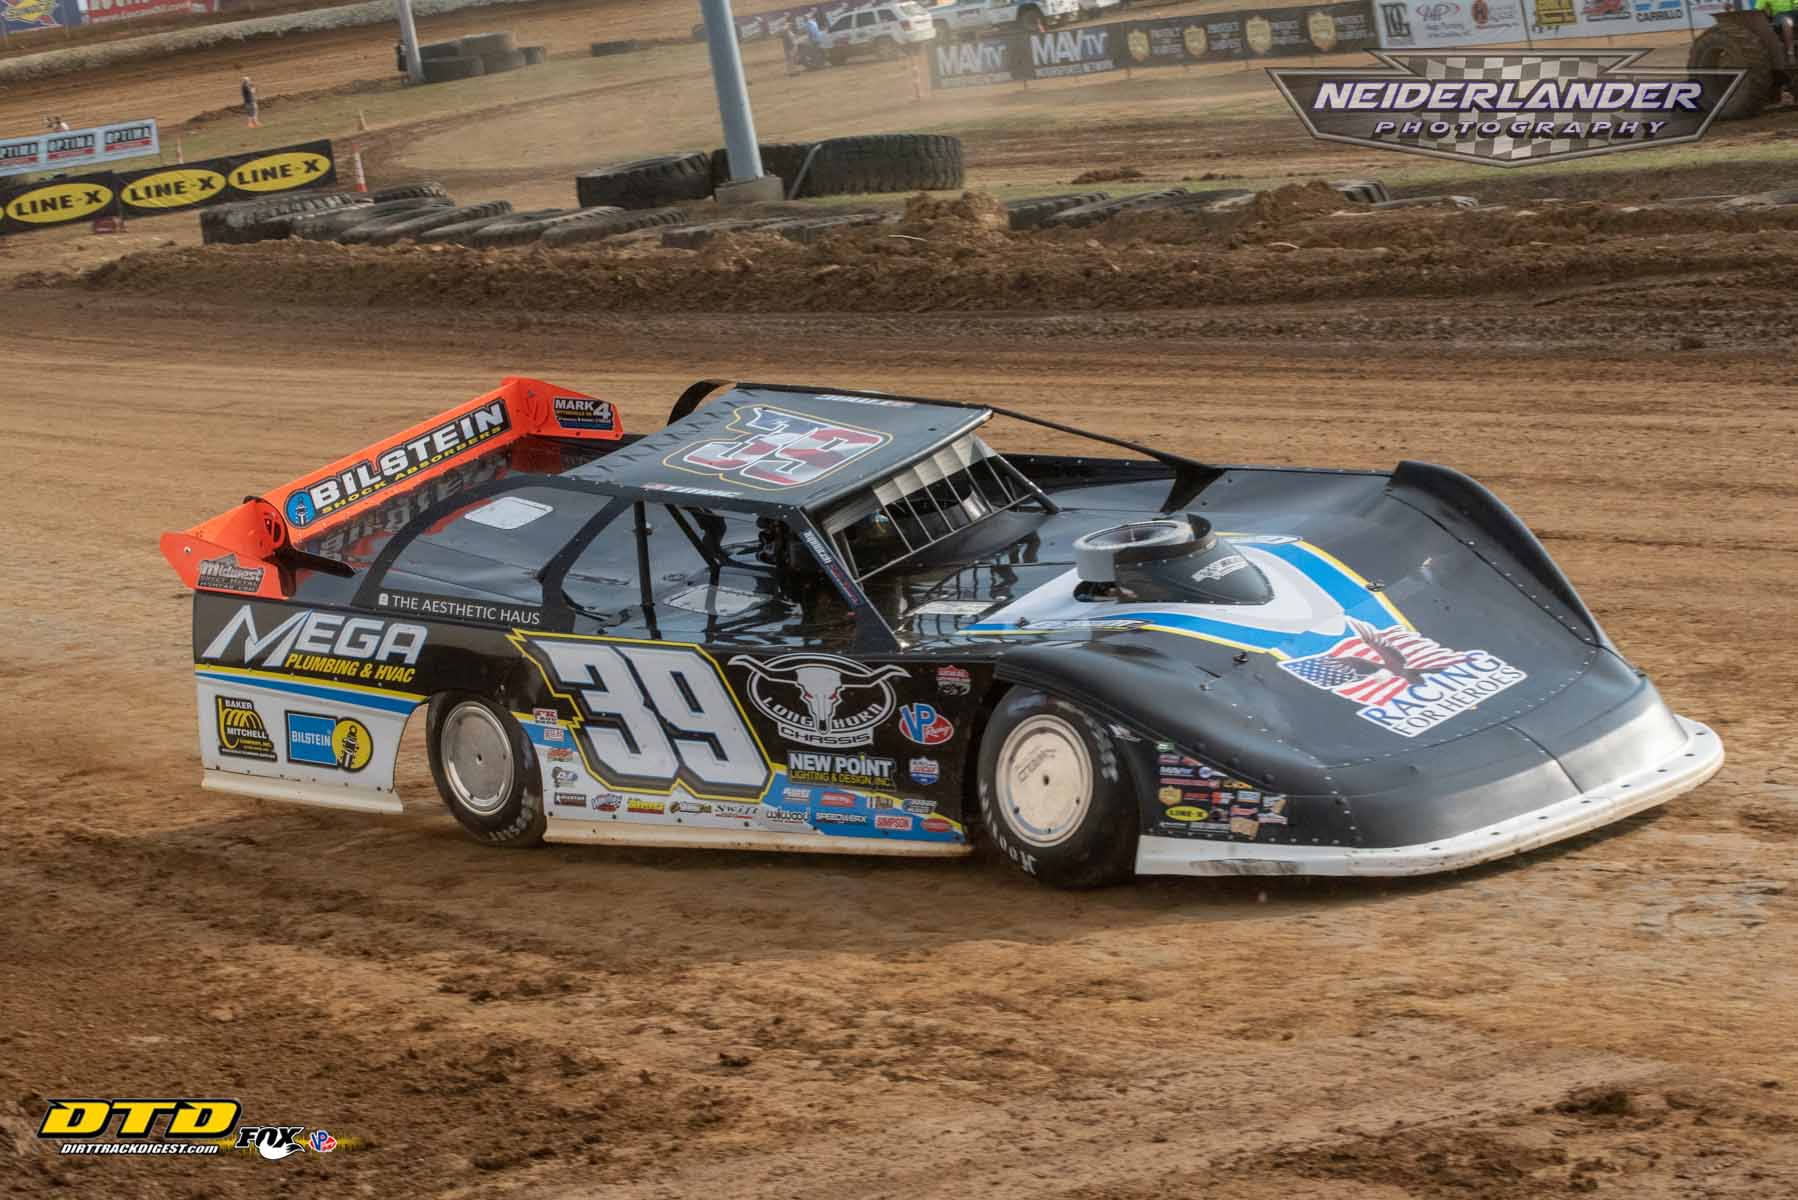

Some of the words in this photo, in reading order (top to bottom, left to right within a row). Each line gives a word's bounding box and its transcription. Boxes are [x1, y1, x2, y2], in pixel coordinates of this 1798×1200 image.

[105, 126, 152, 145] OPTIMA
[236, 158, 320, 185] LINE-X
[128, 176, 215, 202] LINE-X
[15, 190, 102, 217] LINE-X
[555, 399, 594, 411] MARK
[592, 402, 611, 419] 4
[309, 403, 504, 511] BILSTEIN
[321, 480, 387, 514] SHOCK
[394, 426, 502, 481] ABSORBERS
[392, 594, 419, 610] THE
[422, 599, 497, 620] AESTHETIC
[500, 610, 541, 625] HAUS
[201, 604, 428, 668] MEGA
[284, 652, 359, 678] PLUMBING
[360, 663, 373, 678] &
[376, 665, 416, 684] HVAC
[1364, 652, 1502, 727] RACING
[1394, 709, 1447, 735] FOR
[1443, 666, 1522, 712] HEROES
[225, 699, 253, 709] BAKER
[535, 640, 769, 787] 39
[226, 726, 268, 740] MITCHELL
[781, 726, 871, 745] CHASSIS
[899, 703, 937, 743] VP
[291, 730, 331, 748] BILSTEIN
[789, 752, 832, 772] NEW
